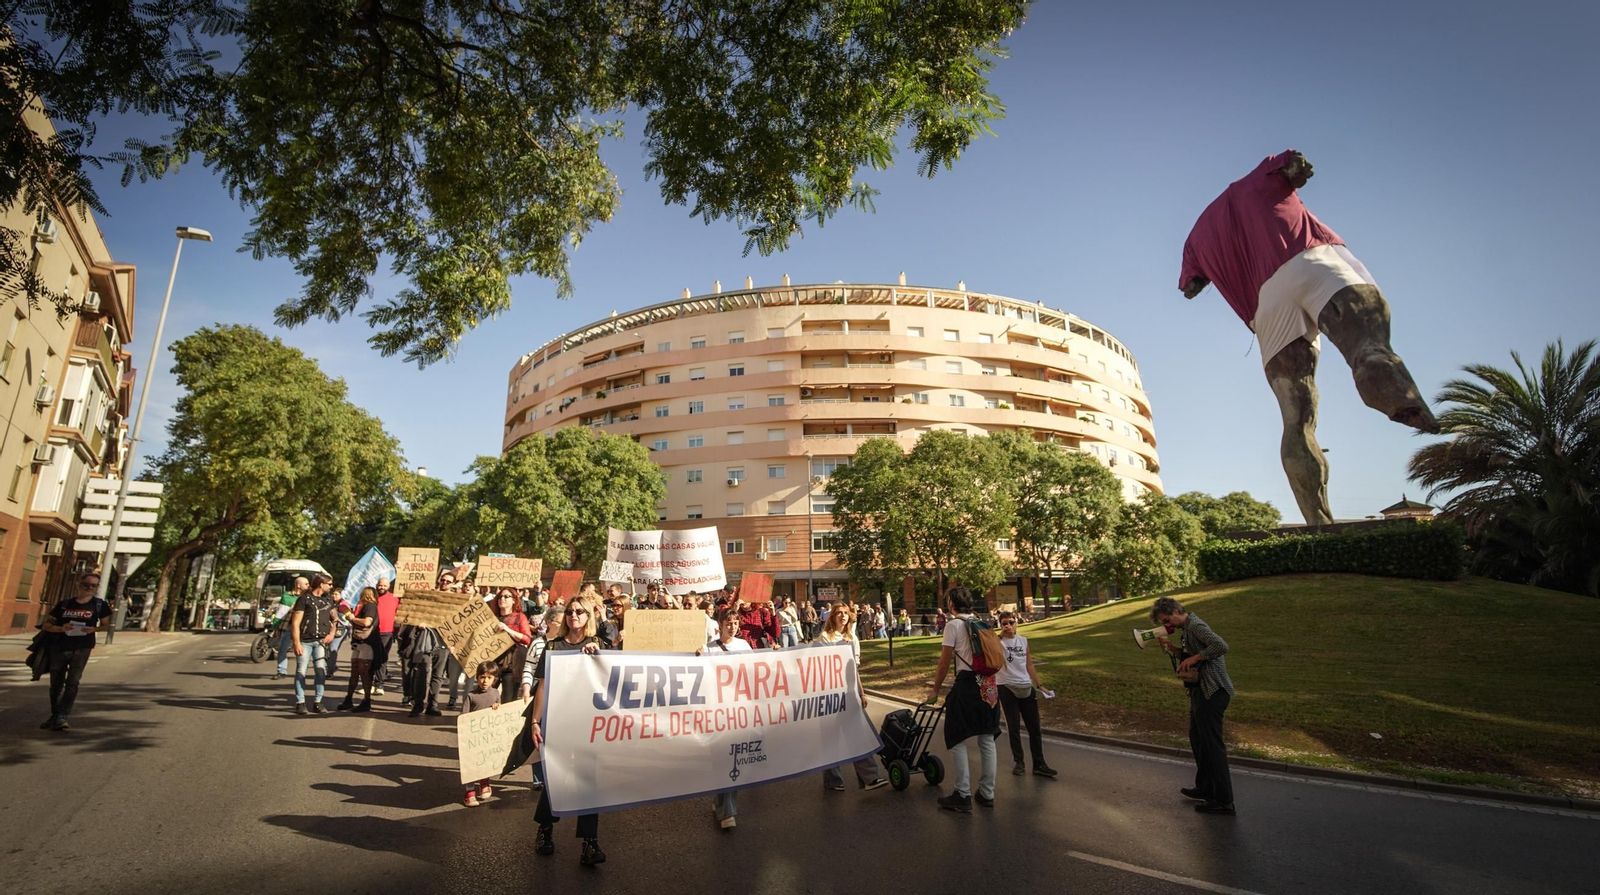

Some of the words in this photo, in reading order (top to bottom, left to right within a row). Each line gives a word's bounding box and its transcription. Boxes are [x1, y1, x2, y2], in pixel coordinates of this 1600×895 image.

[411, 554, 428, 562] TU
[403, 562, 434, 572] AIRBNB
[408, 572, 426, 580] ERA
[664, 574, 722, 586] ESPECULADORES
[409, 582, 430, 590] CASA
[438, 621, 452, 636] NI
[452, 600, 484, 625] CASAS
[447, 630, 464, 646] SIN
[463, 608, 492, 634] GENTE
[456, 647, 470, 662] NI
[468, 622, 497, 650] GENTE
[464, 657, 480, 673] SIN
[480, 638, 506, 660] CASA
[592, 664, 707, 711] JEREZ
[716, 660, 790, 704] PARA
[796, 654, 844, 694] VIVIR
[590, 715, 634, 744] POR
[640, 712, 664, 740] EL
[669, 704, 748, 737] DERECHO
[753, 704, 764, 728] A
[768, 701, 789, 726] LA
[792, 692, 846, 722] VIVIENDA
[729, 740, 762, 756] JEREZ
[736, 754, 767, 766] VIVIENDA
